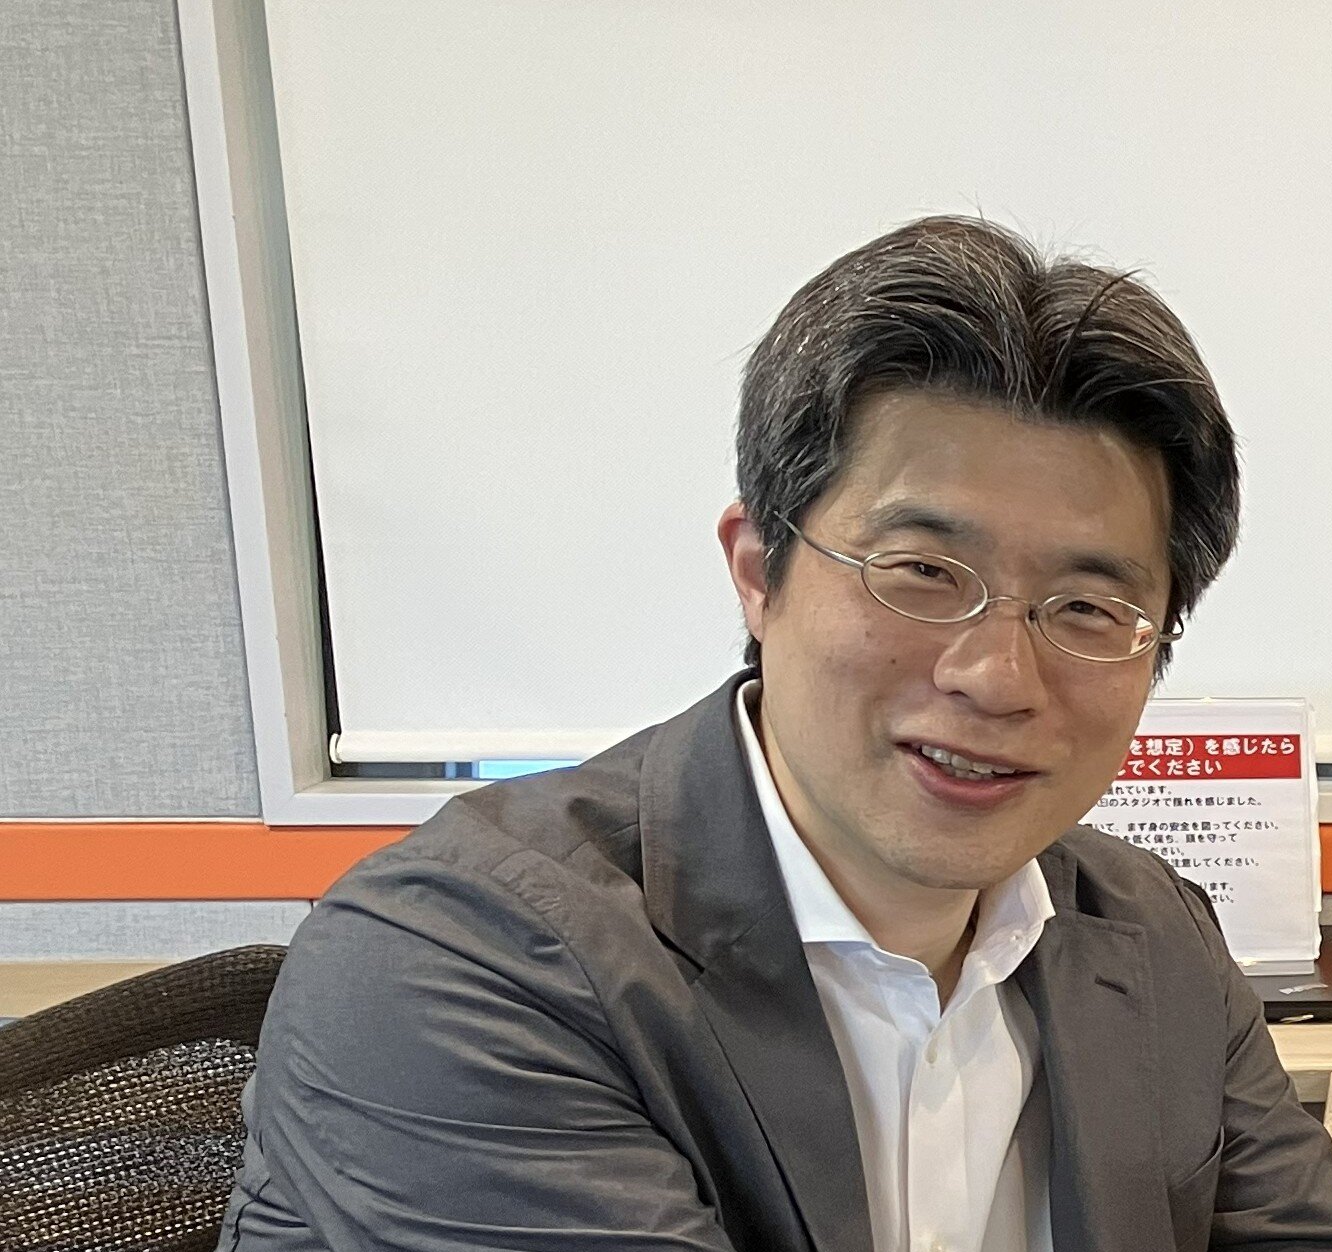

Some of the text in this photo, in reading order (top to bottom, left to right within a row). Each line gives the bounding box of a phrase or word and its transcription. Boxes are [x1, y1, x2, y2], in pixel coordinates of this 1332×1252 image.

[1117, 759, 1223, 776] てください
[1085, 822, 1279, 832] いて、まず身の安全を図ってください。
[1167, 857, 1260, 868] 注意してください。
